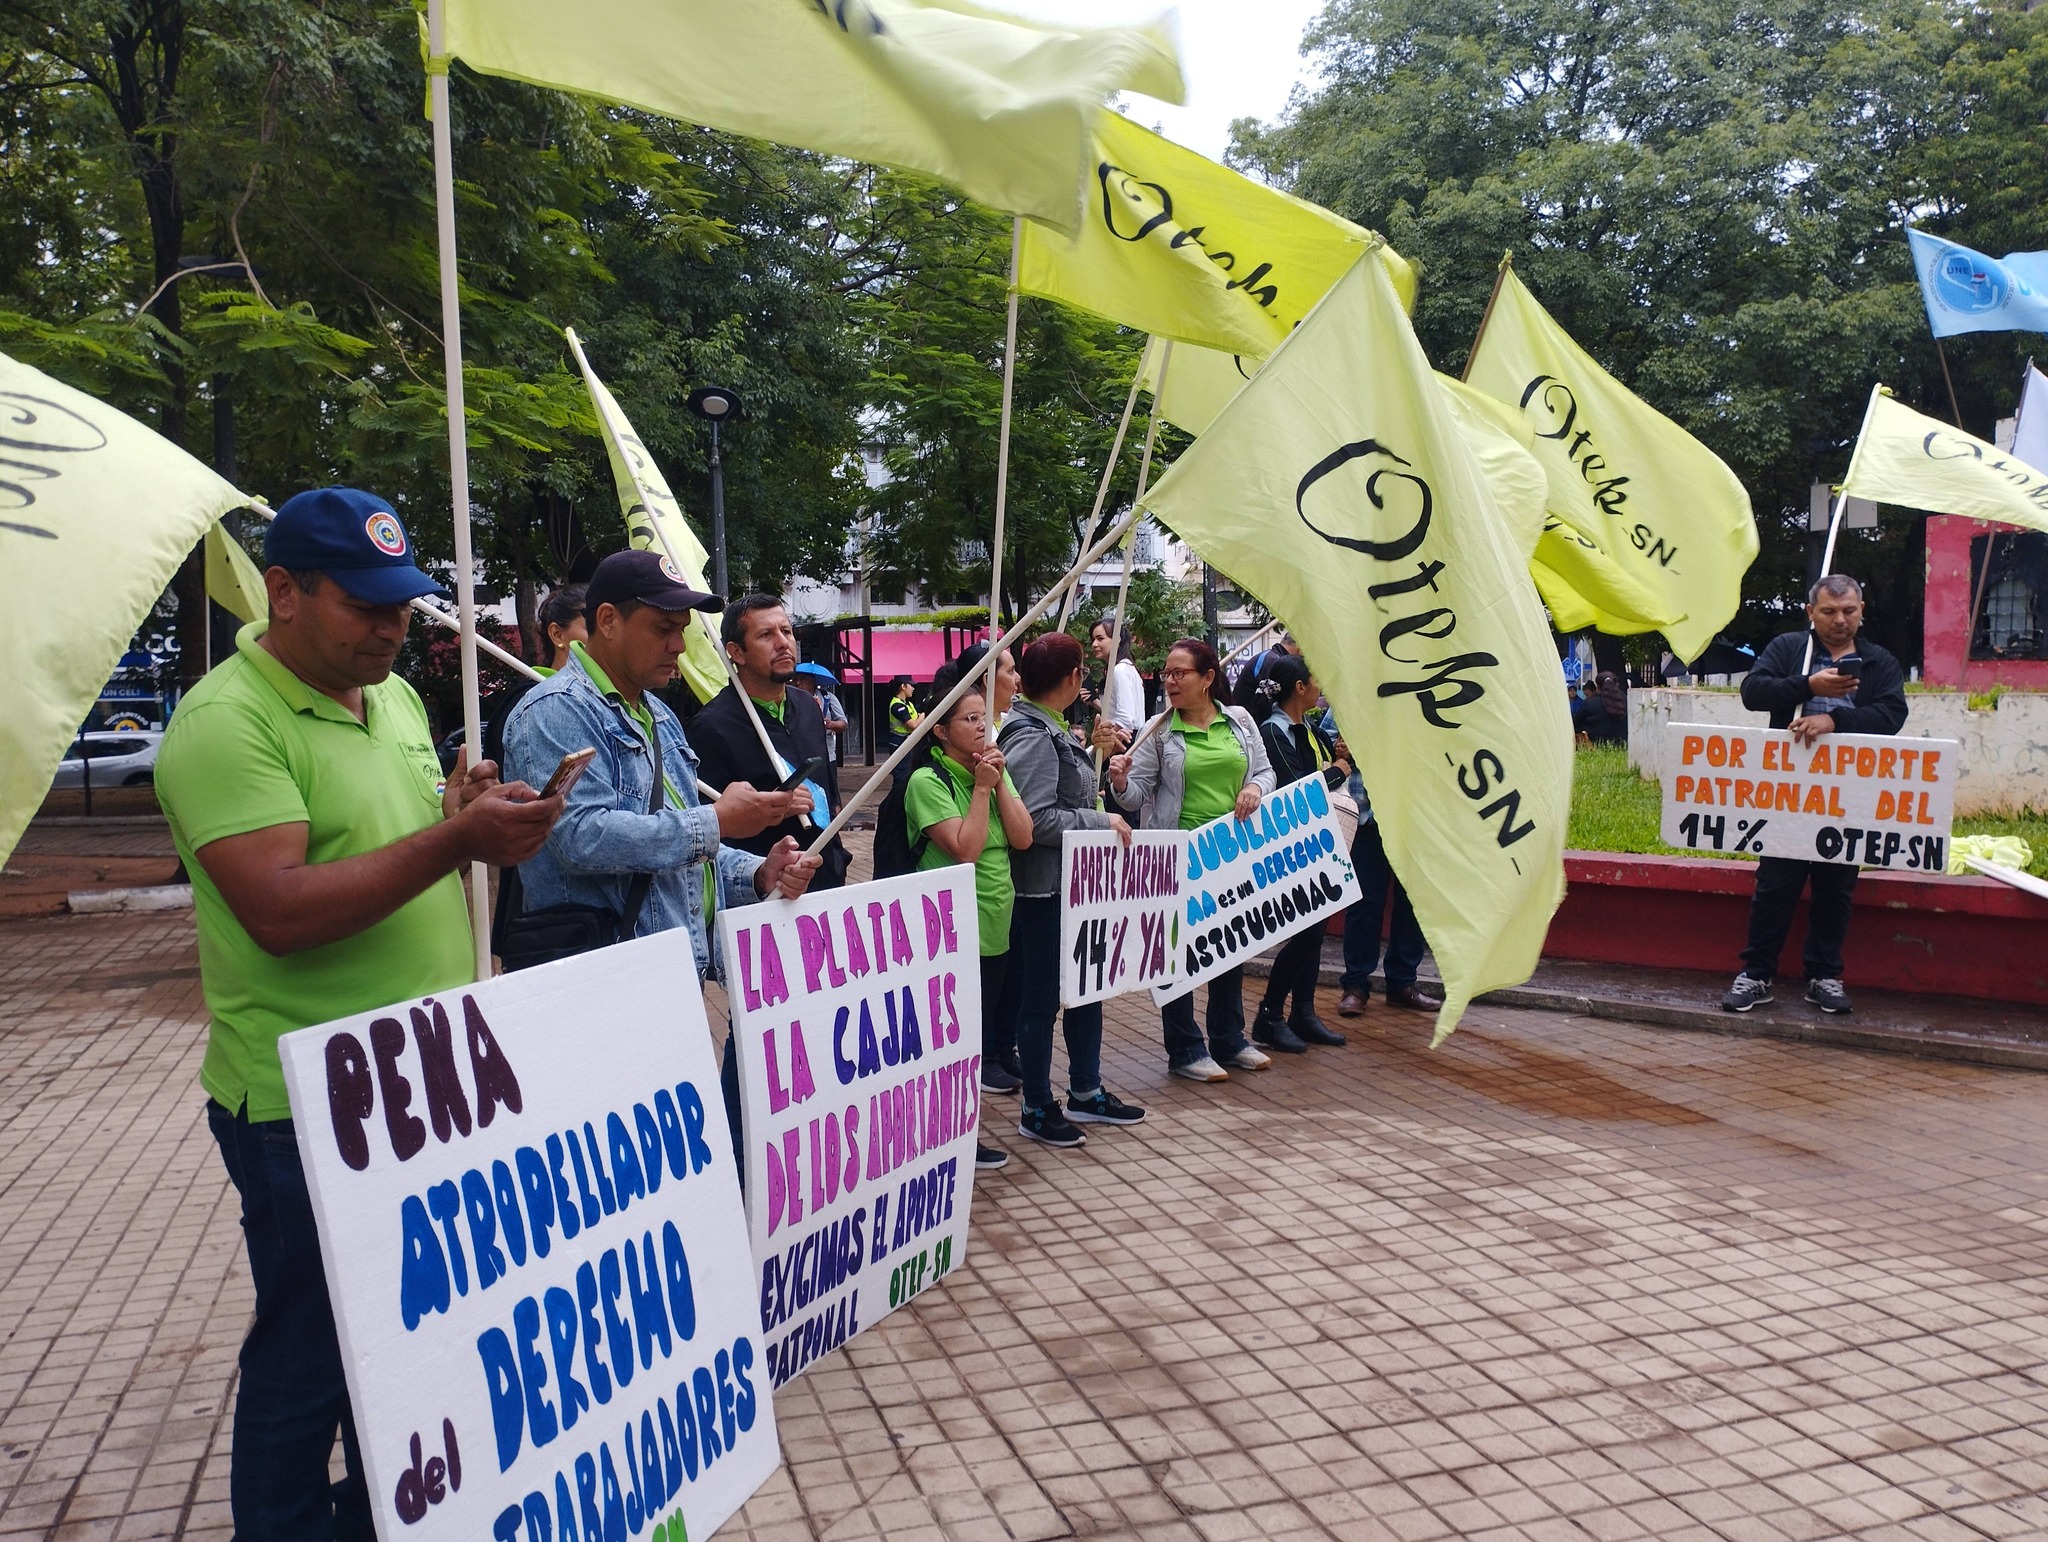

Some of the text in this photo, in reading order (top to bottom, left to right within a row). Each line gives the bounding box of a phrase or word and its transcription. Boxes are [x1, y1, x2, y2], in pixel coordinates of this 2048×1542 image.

[1675, 775, 1934, 825] PATRONAL DEL
[1681, 735, 1941, 783] POR EL APORTE
[1069, 843, 1179, 909] APORTE PATRONAL
[1252, 828, 1336, 890] DERECHO
[1815, 826, 1944, 871] OTEP-SN
[736, 889, 957, 1013] LA PLATA DE
[1073, 915, 1128, 997] 14%
[324, 994, 523, 1171] PEÑA
[763, 971, 962, 1115] LA CAJA ES
[766, 1054, 981, 1239] DE LOS APORTANTES
[400, 1081, 712, 1331] ATROPELLADOR
[760, 1156, 957, 1335] EXIGIMOS EL APORTE
[394, 1219, 696, 1525] del DERECHO
[766, 1288, 859, 1391] PATRONAL
